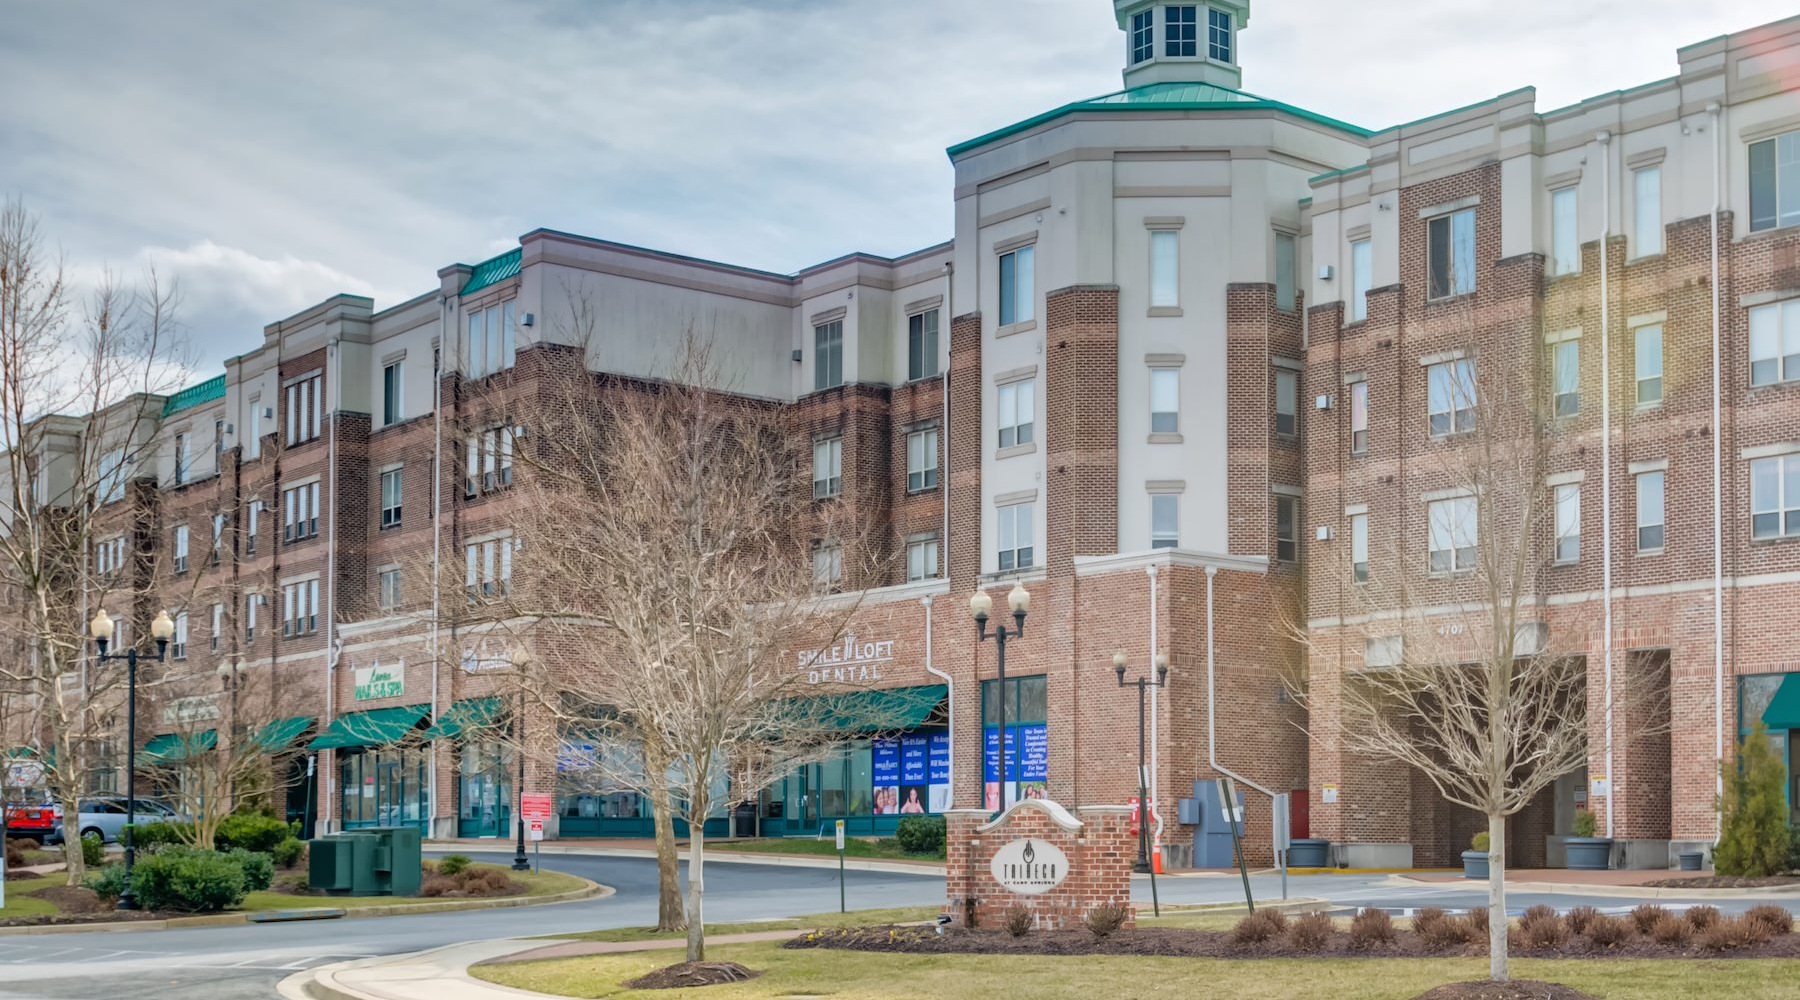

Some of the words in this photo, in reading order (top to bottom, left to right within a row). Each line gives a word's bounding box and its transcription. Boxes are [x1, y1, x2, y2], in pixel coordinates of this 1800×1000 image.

[798, 646, 841, 665] SMILE
[855, 640, 894, 659] LOFT
[809, 664, 881, 684] DENTAL
[1004, 863, 1056, 879] TRIBECA
